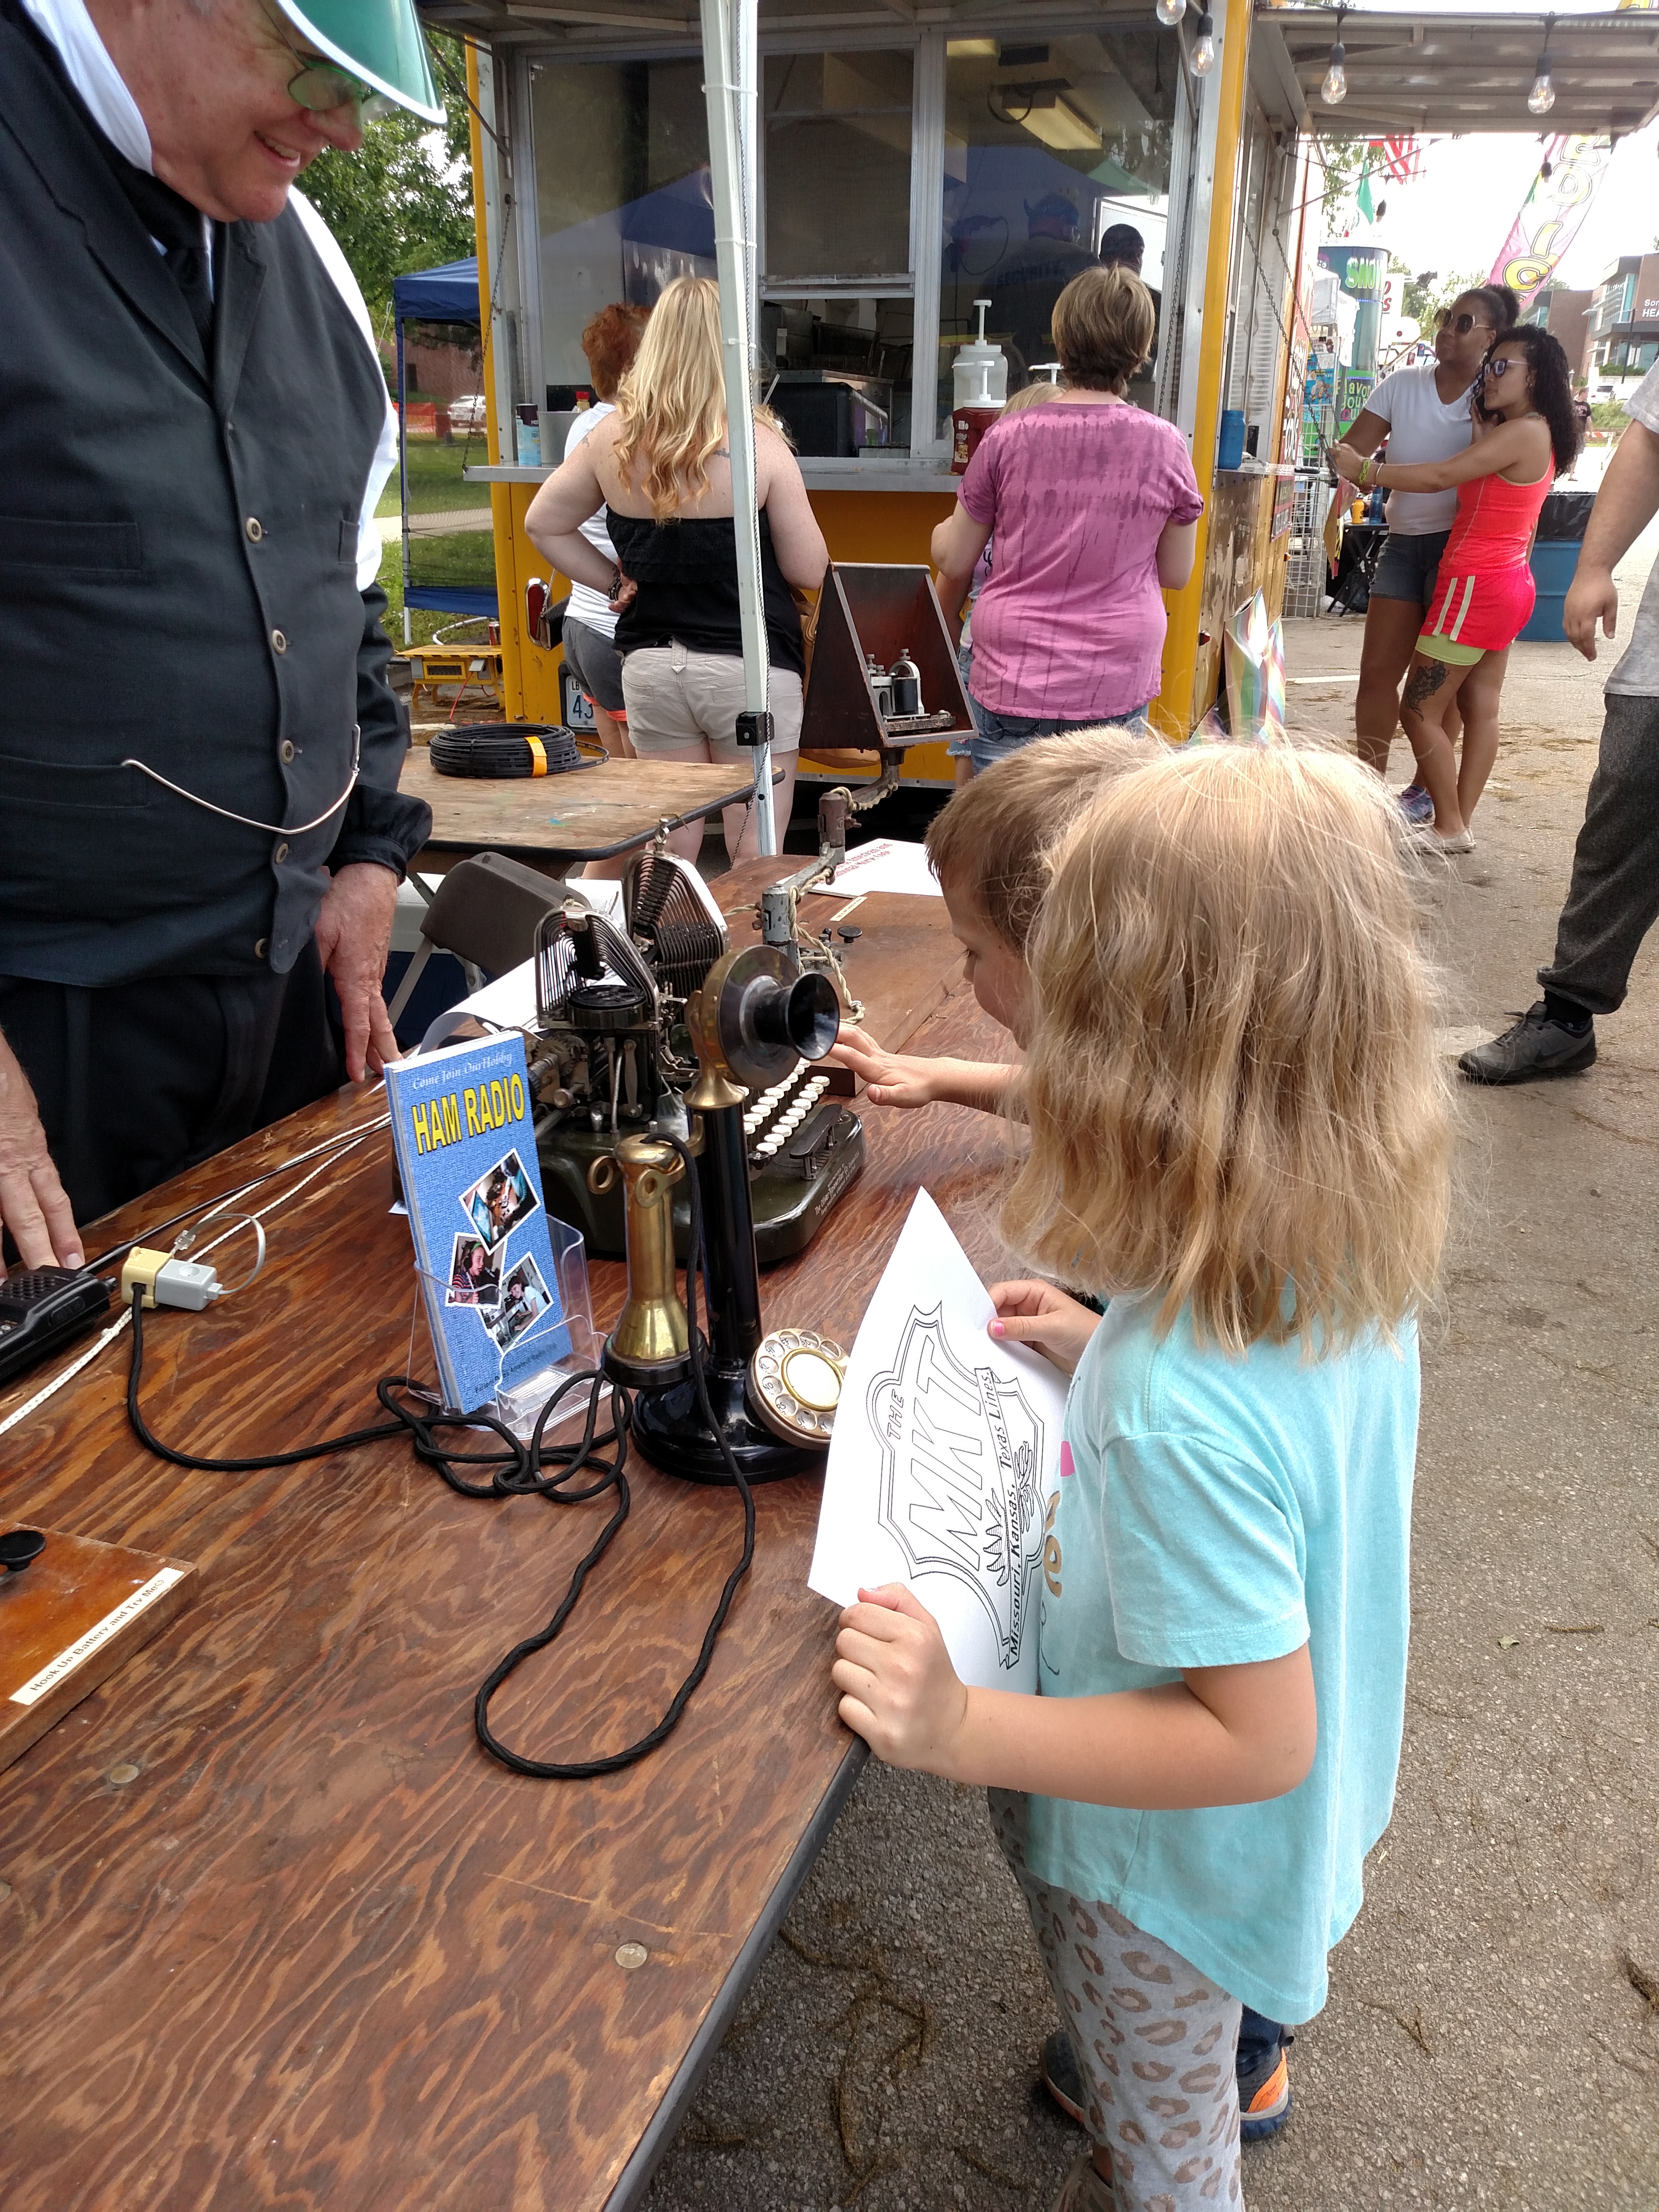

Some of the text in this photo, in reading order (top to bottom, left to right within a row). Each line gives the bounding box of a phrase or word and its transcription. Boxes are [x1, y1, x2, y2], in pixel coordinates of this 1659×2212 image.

[572, 681, 580, 690] LB
[411, 1072, 525, 1156] HAM RADIO
[821, 1192, 830, 1208] Oliver
[828, 1170, 844, 1197] Typewriter
[887, 1389, 904, 1440] THE
[981, 1372, 1001, 1420] Lines.
[909, 1334, 983, 1571] MKT
[994, 1425, 1012, 1469] Texas
[30, 1585, 158, 1691] Hook Up Battery and Try Me
